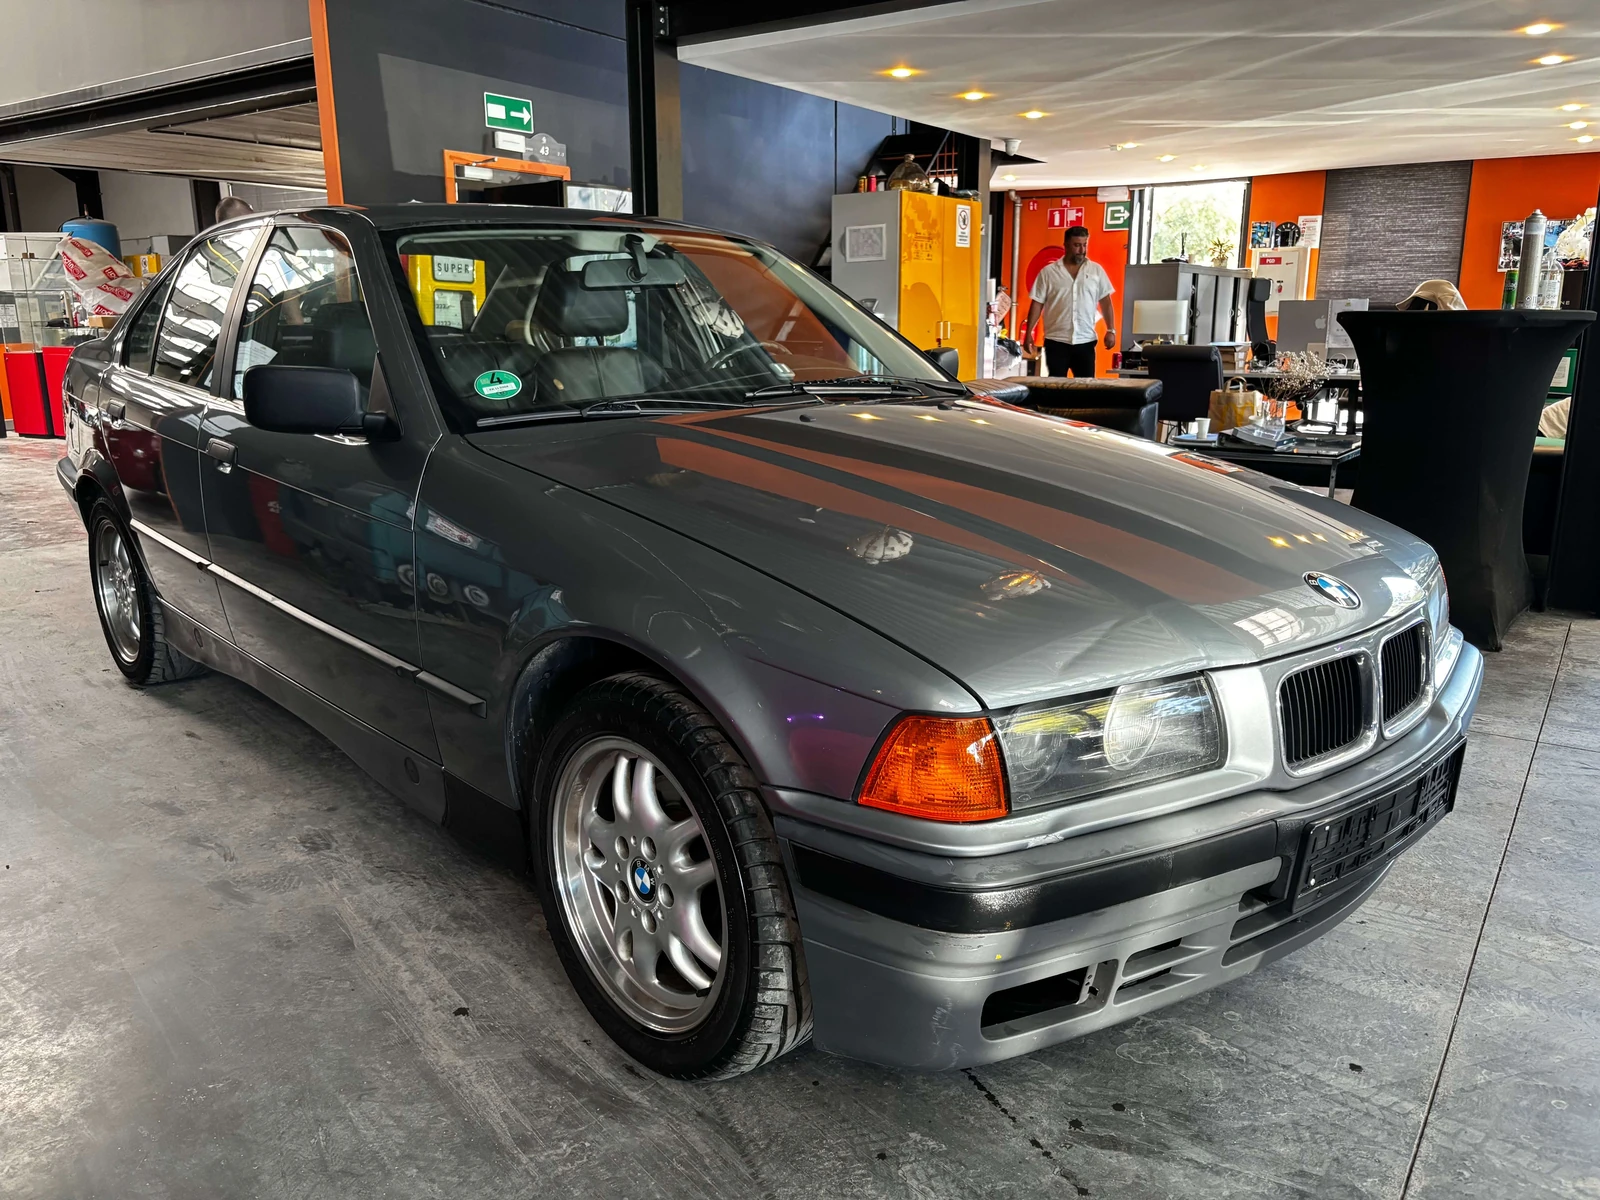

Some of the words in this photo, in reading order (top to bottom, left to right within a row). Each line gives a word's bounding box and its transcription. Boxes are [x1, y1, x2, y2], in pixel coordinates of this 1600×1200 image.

[540, 146, 550, 156] 43
[436, 262, 470, 274] SUPER
[490, 372, 503, 384] 4
[636, 860, 656, 886] BMW
